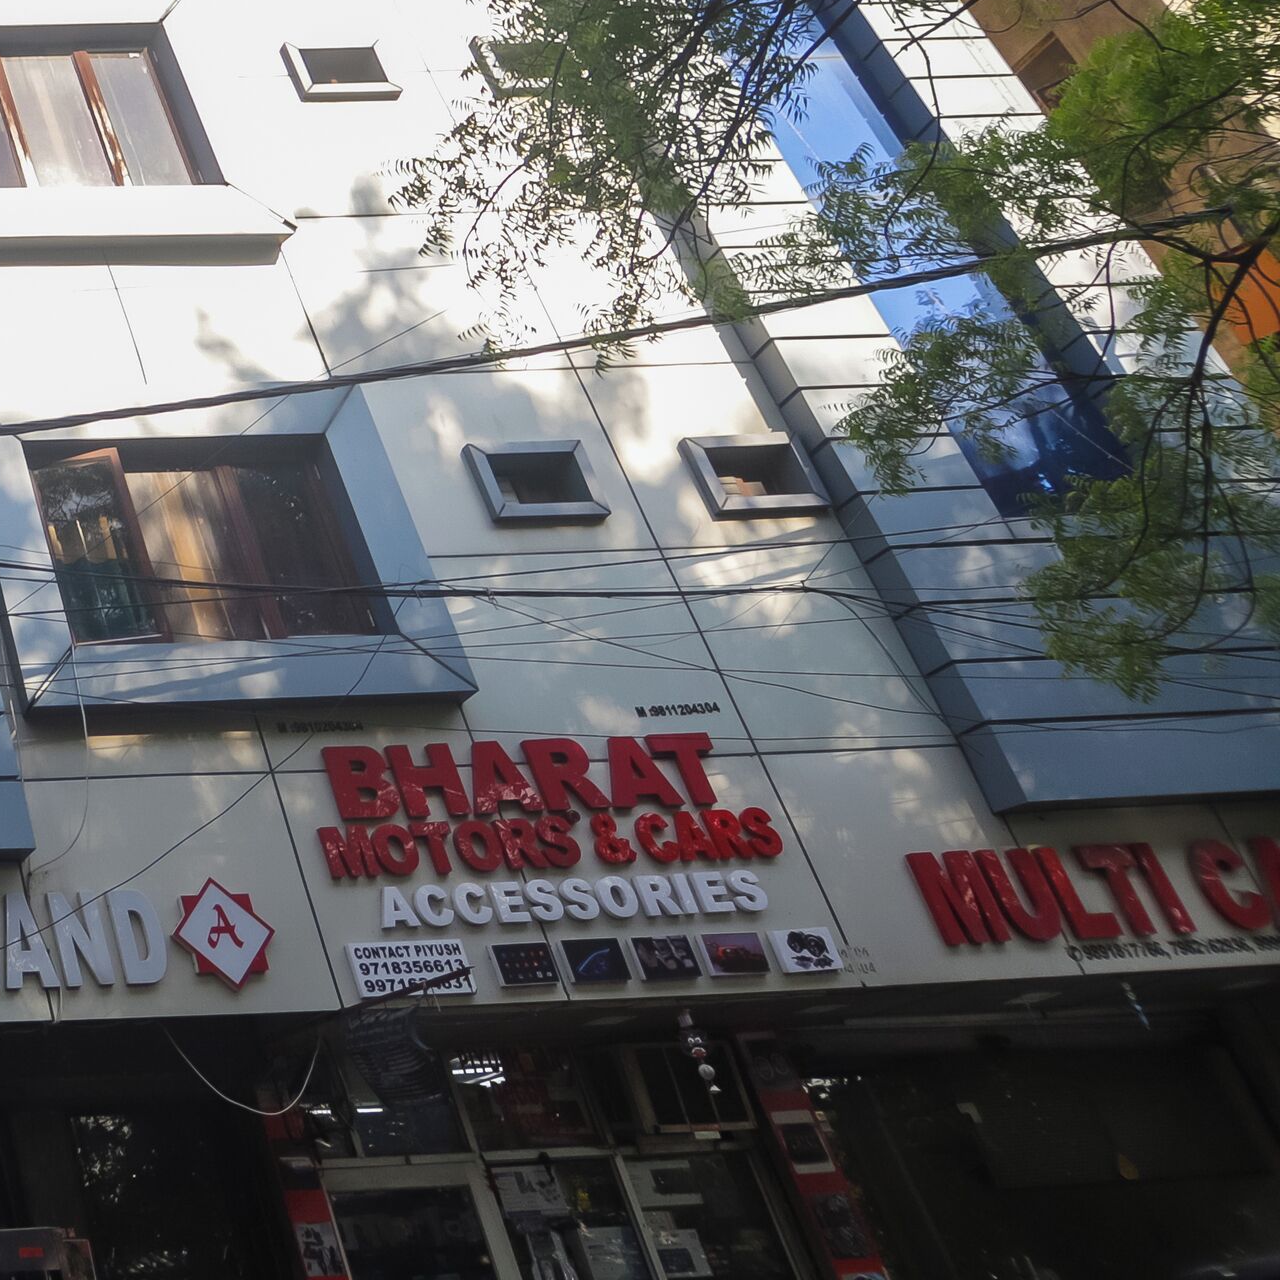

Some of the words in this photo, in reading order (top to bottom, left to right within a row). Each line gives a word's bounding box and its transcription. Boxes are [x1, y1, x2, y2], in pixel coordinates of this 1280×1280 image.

[321, 732, 719, 821] BHARAT
[316, 815, 582, 880] MOTORS
[590, 812, 637, 864] &
[634, 807, 784, 864] CARS
[381, 870, 769, 930] ACCESSORIES
[905, 842, 1197, 947] MULTI
[354, 945, 410, 960] CONTACT
[413, 943, 462, 957] PIYUSH
[359, 959, 466, 976] 9718356613
